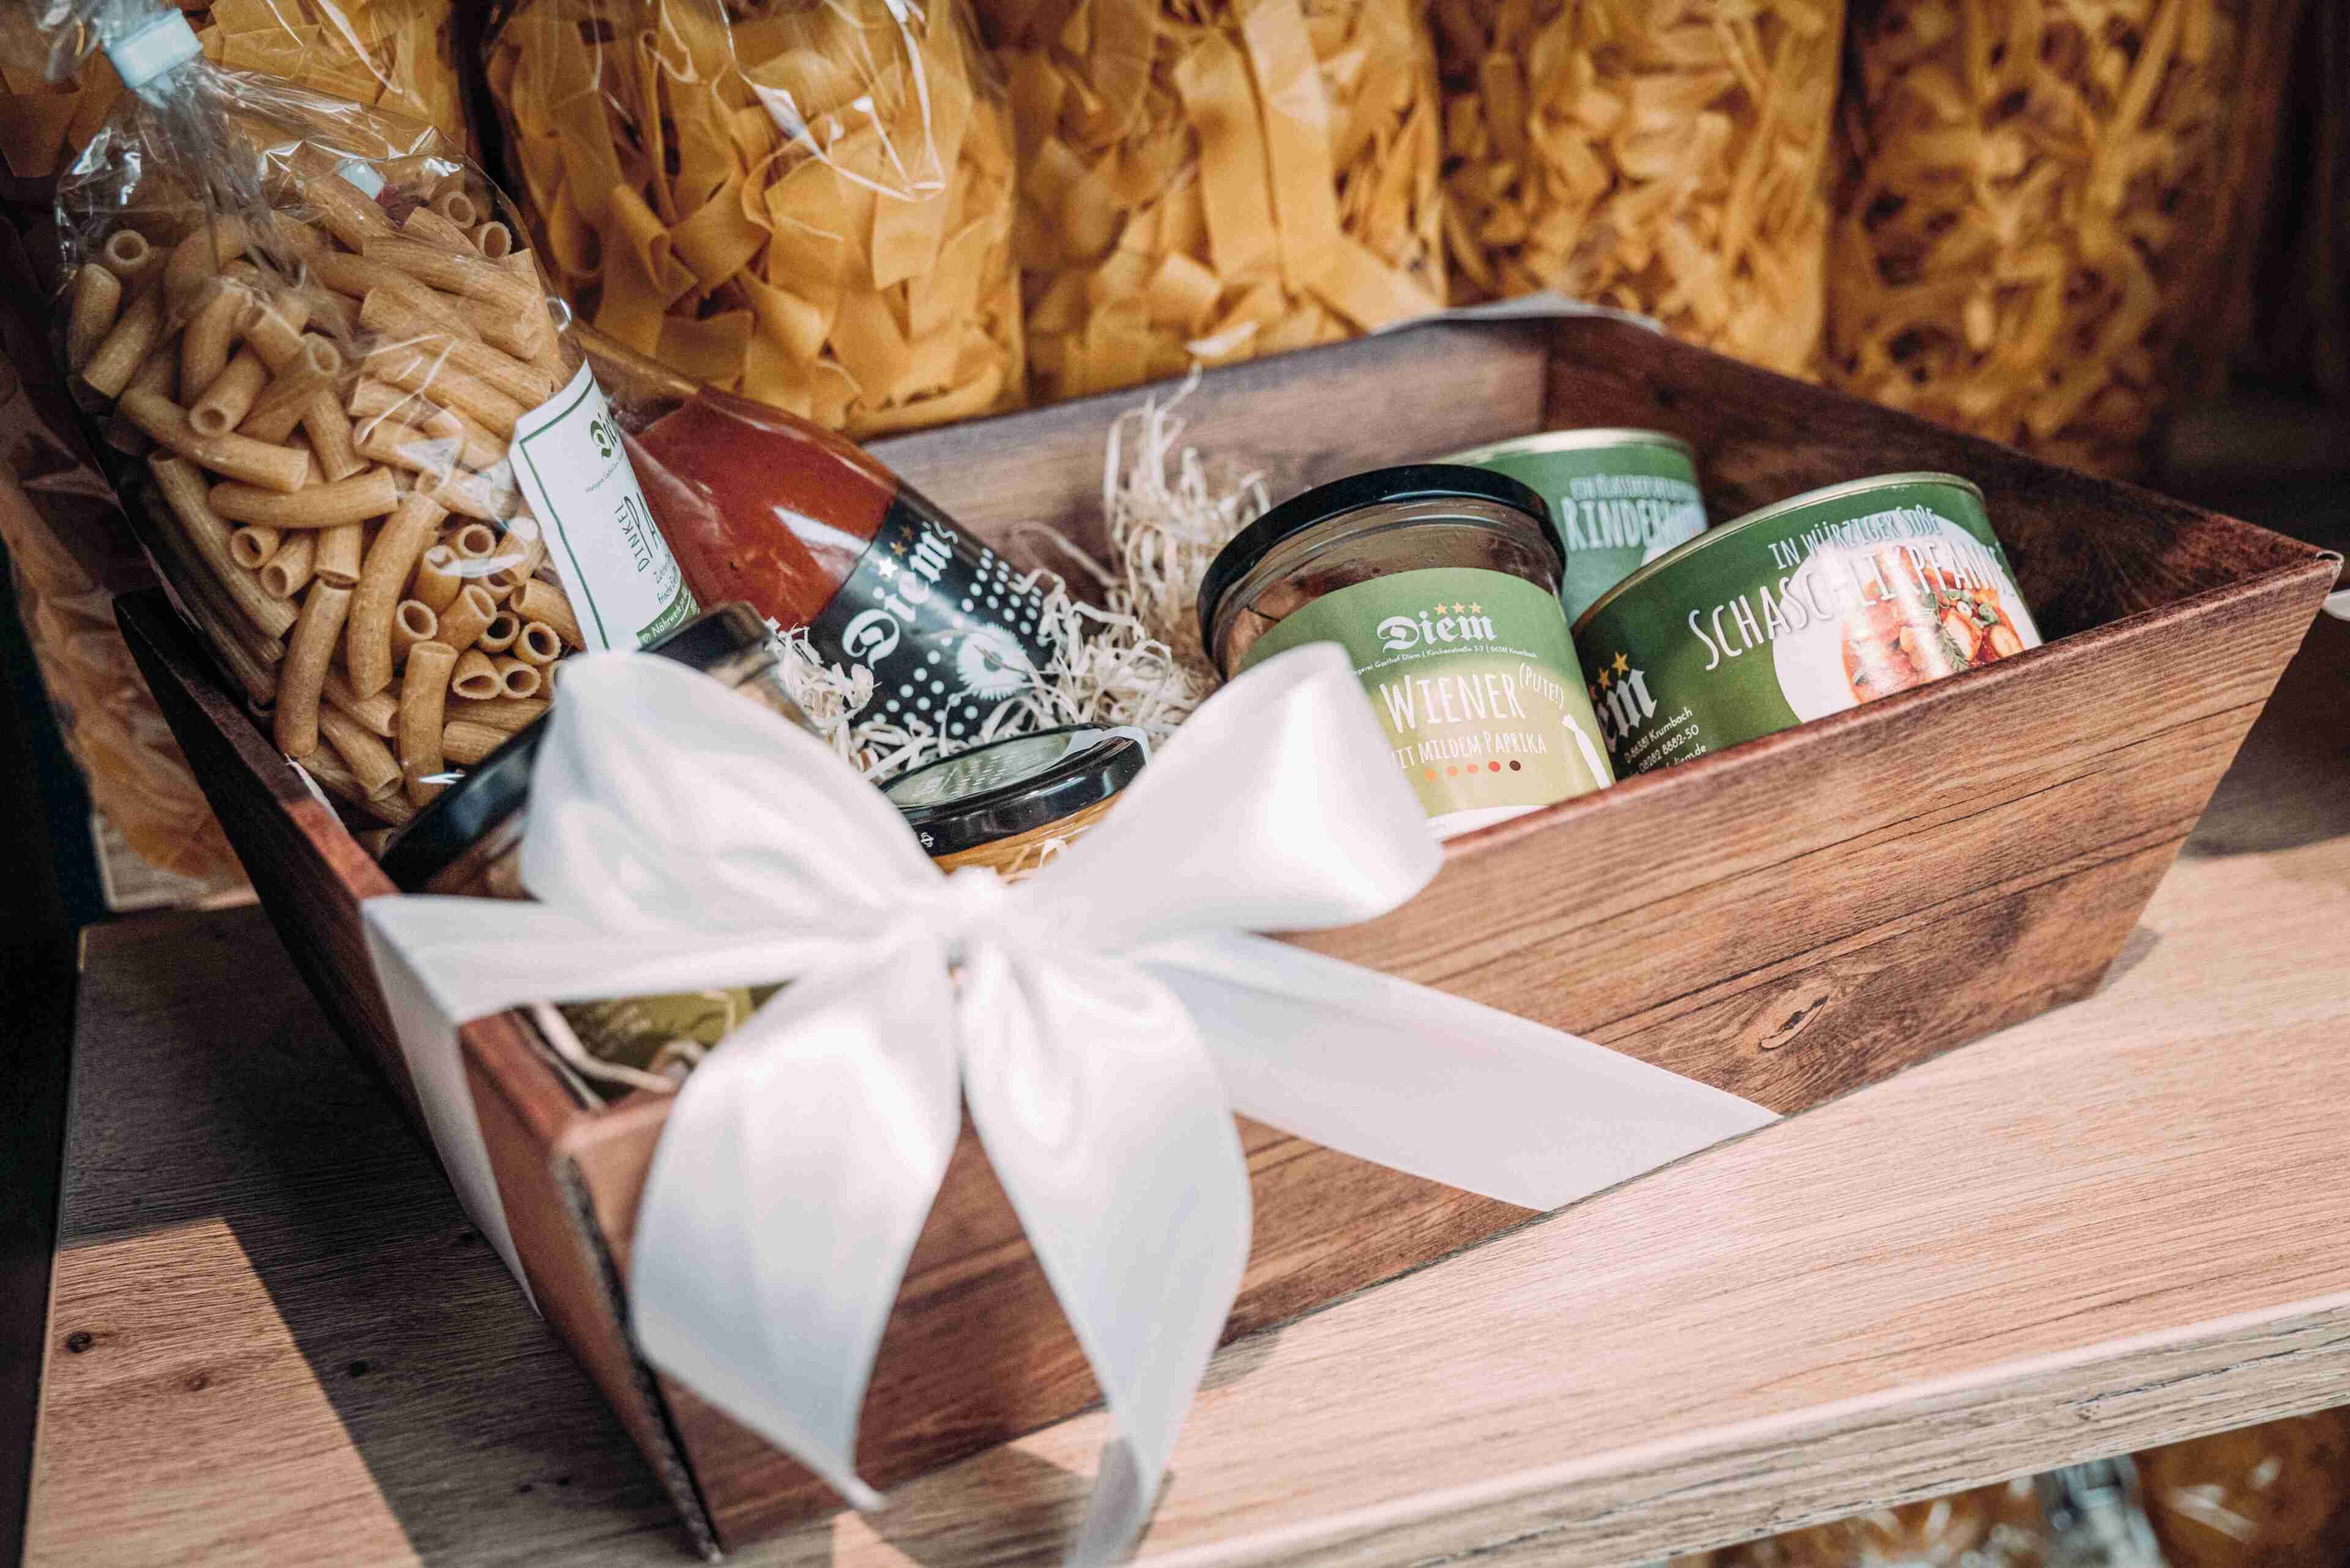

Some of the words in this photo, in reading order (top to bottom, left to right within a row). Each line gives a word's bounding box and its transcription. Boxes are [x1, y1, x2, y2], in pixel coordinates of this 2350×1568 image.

[614, 499, 651, 572] DINKEL
[1768, 537, 1802, 570] IN
[1800, 513, 1901, 559] WÜRZIGER
[1377, 610, 1499, 654] Diem
[1402, 652, 1420, 662] Diem
[1379, 674, 1527, 734] WIENER
[1597, 669, 1657, 753] em
[1649, 706, 1693, 742] Krumbach
[1390, 745, 1415, 770] IT
[1418, 734, 1482, 764] MILDEM
[1482, 730, 1548, 755] PAPRIKA
[1662, 724, 1699, 756] 8882-50
